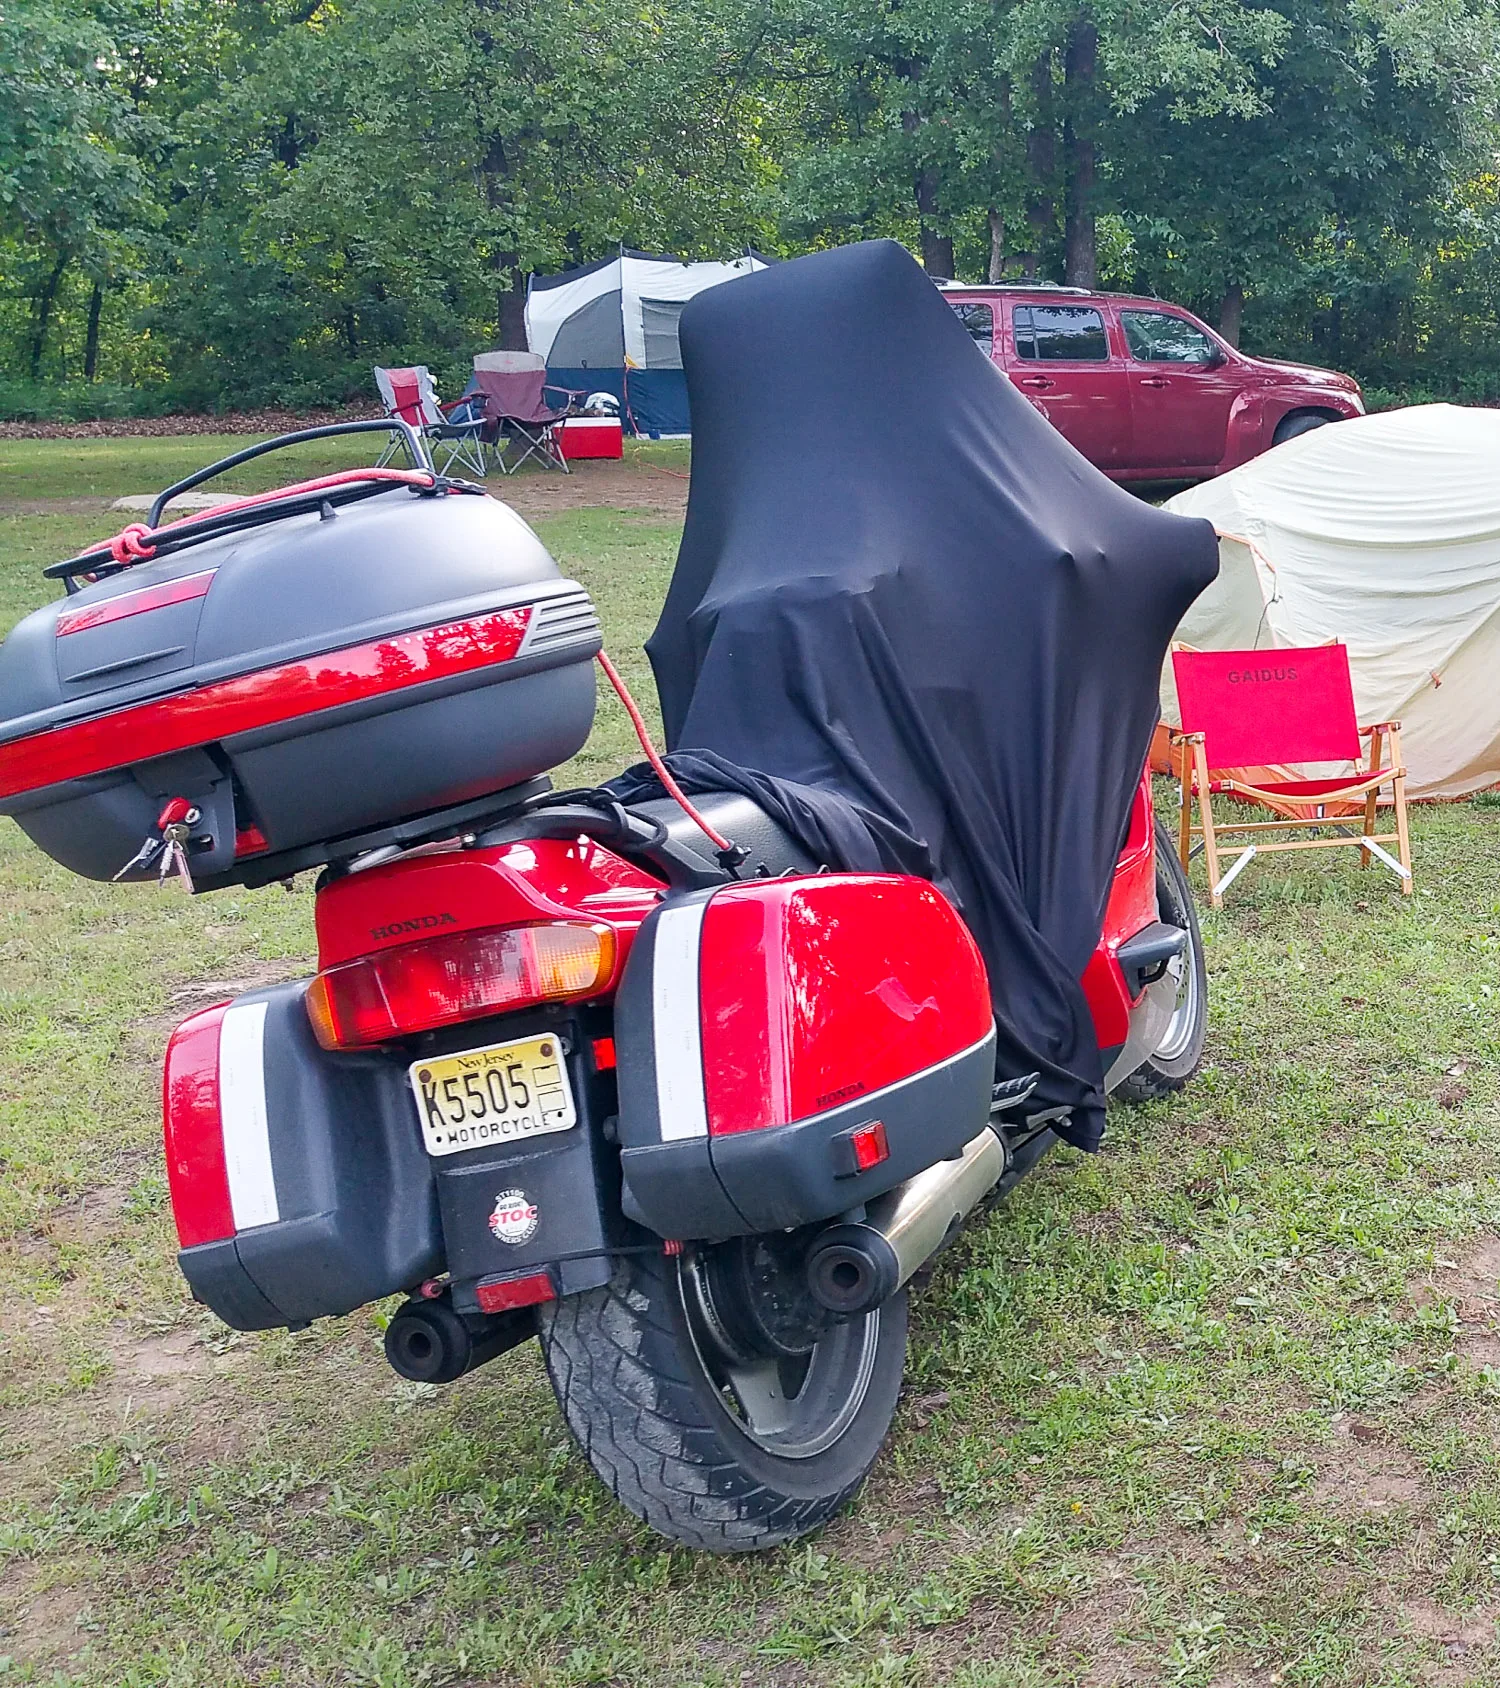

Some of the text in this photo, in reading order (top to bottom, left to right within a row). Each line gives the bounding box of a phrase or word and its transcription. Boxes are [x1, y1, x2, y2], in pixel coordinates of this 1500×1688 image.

[1228, 667, 1298, 684] GAIDUS
[369, 912, 457, 940] HONDA
[457, 1053, 514, 1070] New Jersey
[421, 1063, 530, 1128] K5505
[816, 1081, 865, 1107] HONDA
[448, 1112, 550, 1144] MOTORCYCLE
[488, 1205, 538, 1227] STOC
